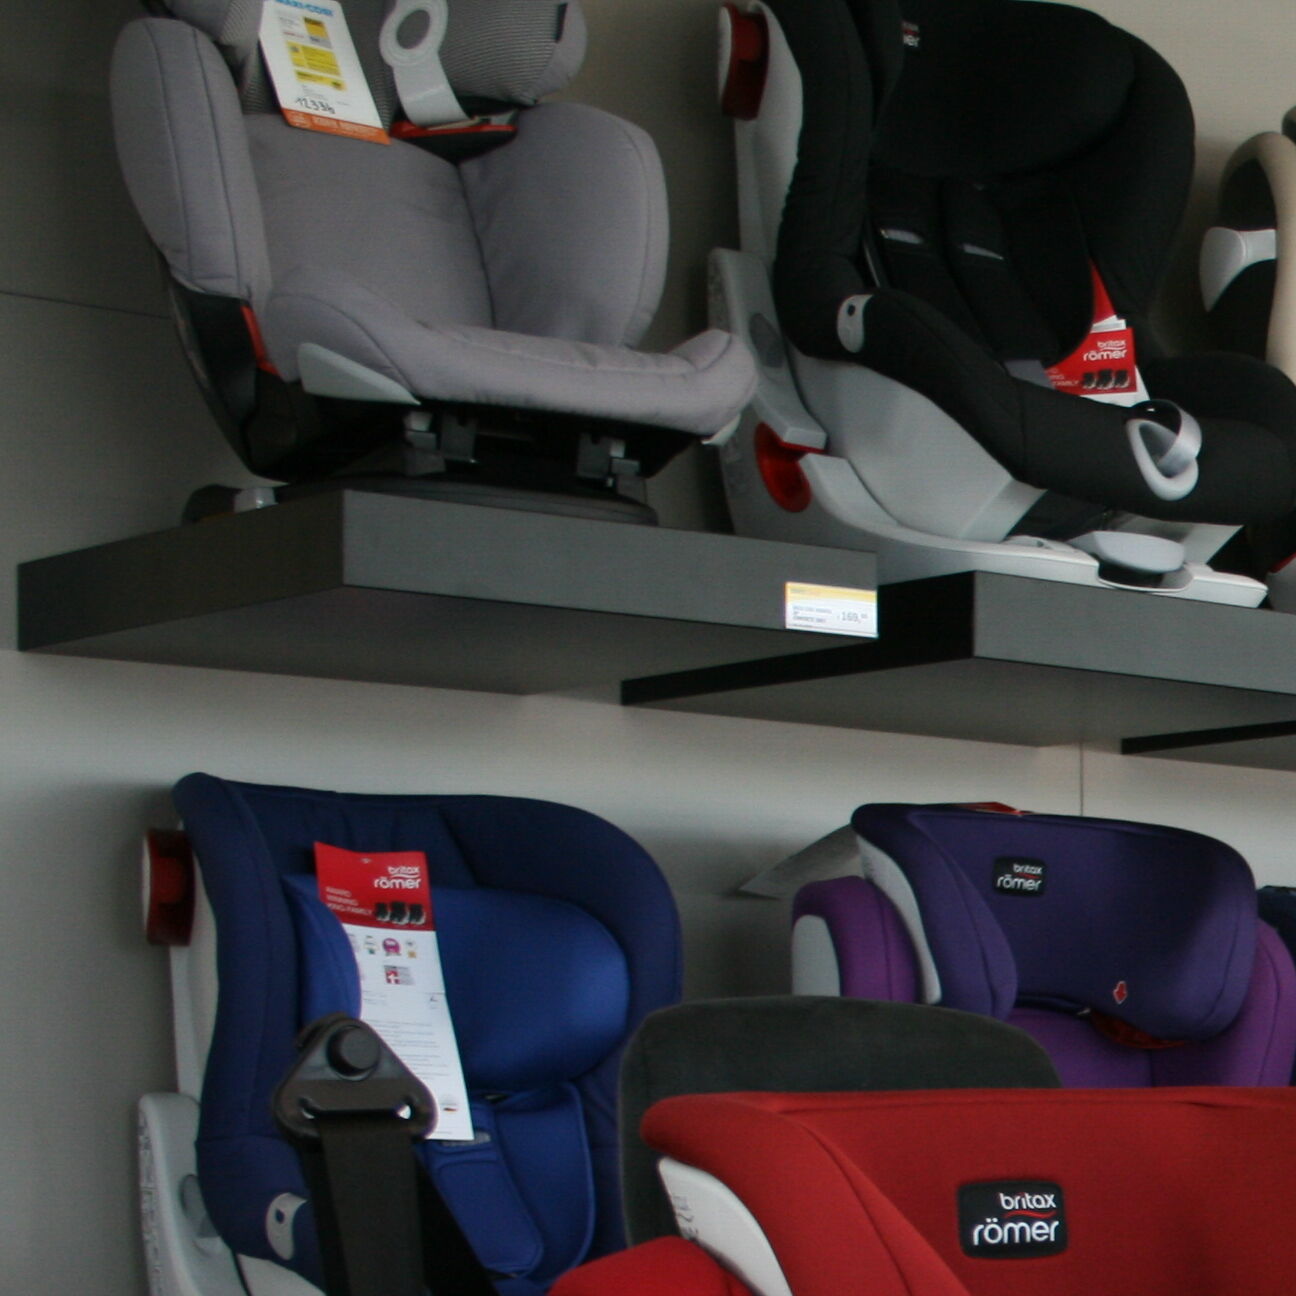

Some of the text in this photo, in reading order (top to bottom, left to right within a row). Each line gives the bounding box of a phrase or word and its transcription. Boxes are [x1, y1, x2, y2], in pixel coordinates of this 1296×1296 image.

[1083, 350, 1127, 361] römer
[1013, 863, 1043, 874] britax
[374, 877, 421, 889] römer
[996, 874, 1042, 891] römer
[999, 1192, 1057, 1210] britax
[972, 1217, 1059, 1246] römer
